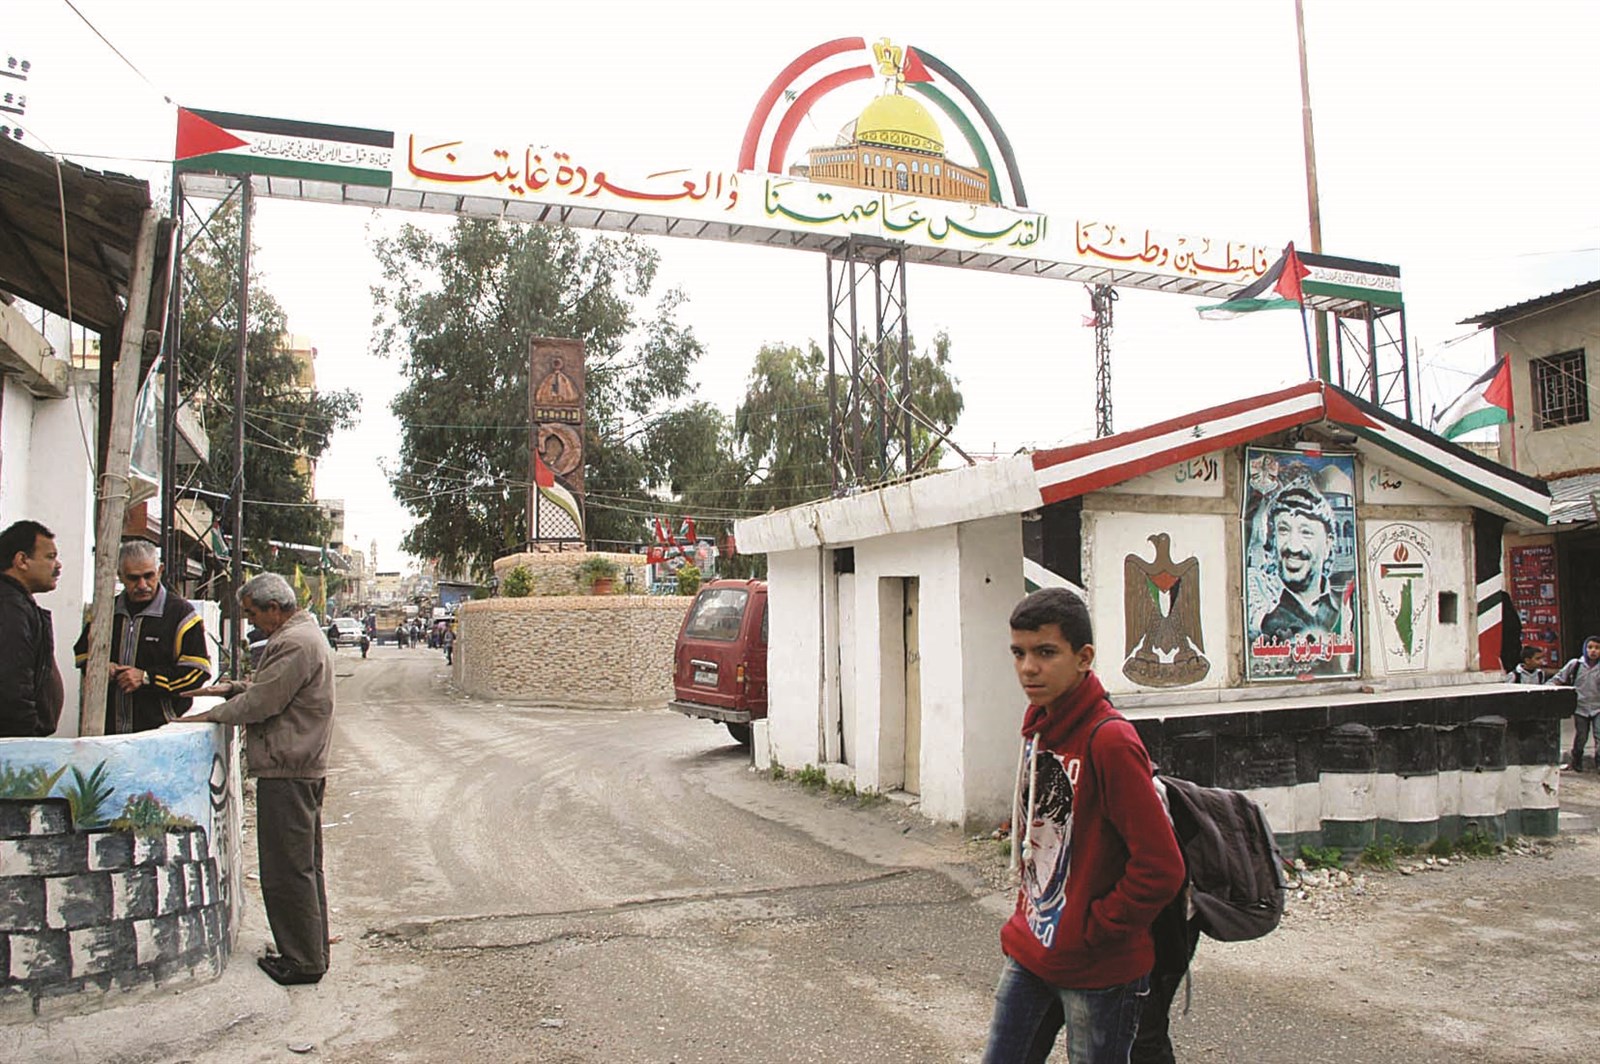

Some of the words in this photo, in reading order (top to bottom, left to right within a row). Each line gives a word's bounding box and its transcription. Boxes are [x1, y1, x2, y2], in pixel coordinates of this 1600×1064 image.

[369, 152, 392, 169] قيادة
[407, 132, 552, 196] غايتنا
[763, 179, 926, 232] عاصمتنا
[926, 211, 1049, 247] القدس
[1075, 220, 1169, 267] وطننا
[1173, 236, 1269, 277] فلسطين
[1251, 632, 1292, 663] عينيك
